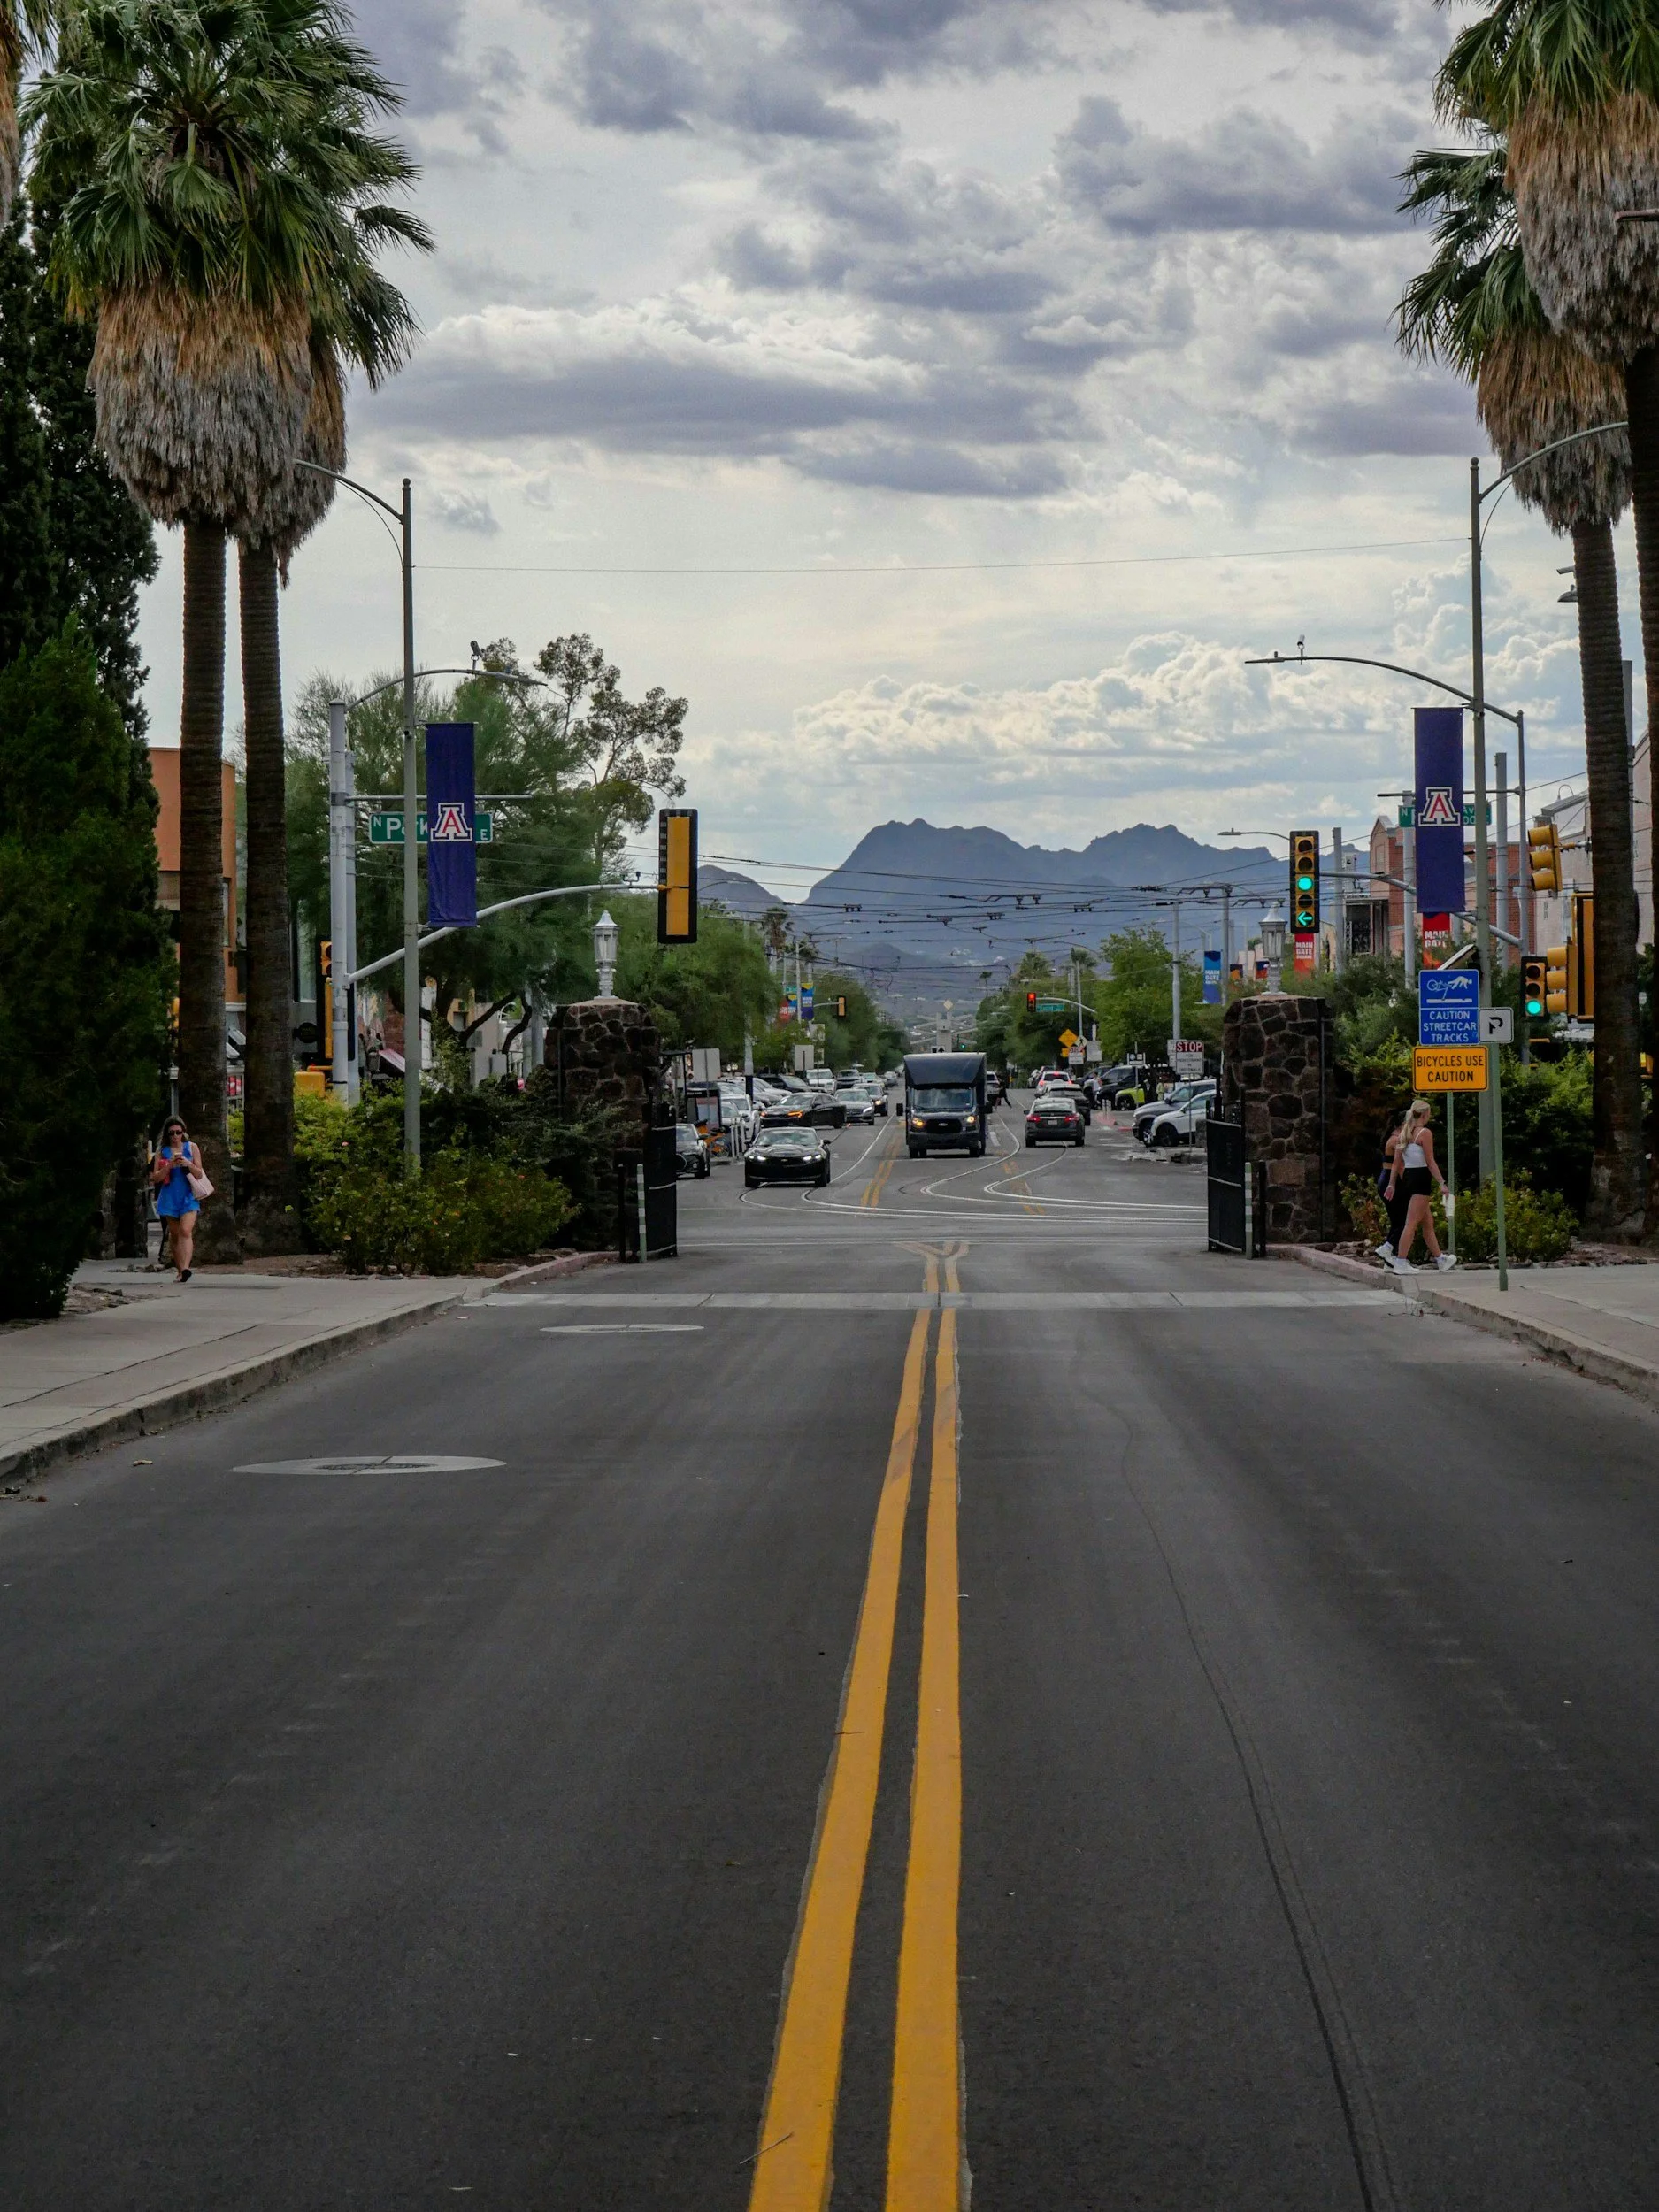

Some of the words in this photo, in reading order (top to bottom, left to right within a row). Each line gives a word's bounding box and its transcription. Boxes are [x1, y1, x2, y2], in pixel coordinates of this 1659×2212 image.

[1418, 787, 1460, 826] A
[373, 816, 381, 827] N
[387, 818, 427, 839] Pk
[430, 803, 472, 841] A
[480, 829, 488, 841] E
[1429, 1010, 1470, 1020] CAUTION
[1423, 1022, 1477, 1032] STREETCAR
[1431, 1033, 1469, 1042] TRACKS
[1177, 1041, 1202, 1052] STOP
[1417, 1056, 1462, 1067] BICYCLES
[1465, 1056, 1484, 1066] USE
[1427, 1071, 1474, 1082] CAUTION
